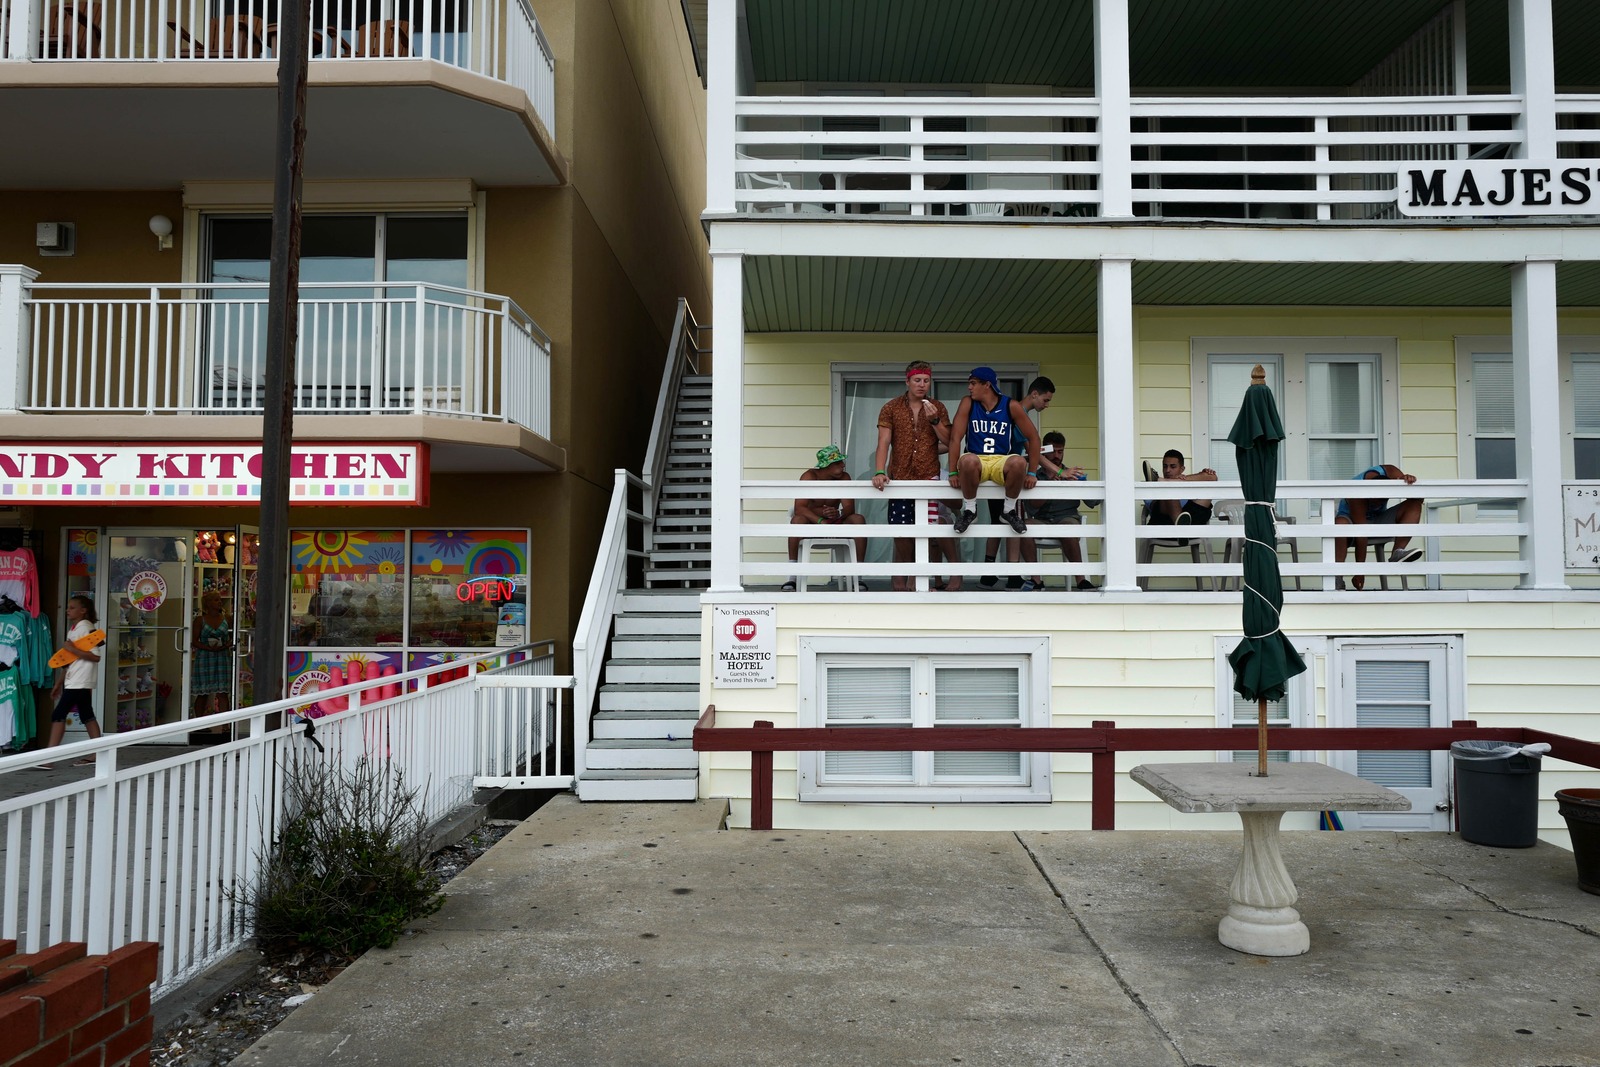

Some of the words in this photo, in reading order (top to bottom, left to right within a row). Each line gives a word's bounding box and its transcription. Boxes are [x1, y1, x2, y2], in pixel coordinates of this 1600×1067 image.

[1408, 167, 1600, 206] MAJES
[972, 420, 1007, 435] DUKE
[983, 437, 995, 453] 2
[1592, 556, 1600, 564] 4
[456, 582, 512, 602] OPEN
[732, 609, 770, 617] Trespassing
[736, 625, 755, 635] STOP
[720, 652, 771, 661] MAJESTIC
[727, 662, 763, 670] HOTEL
[292, 673, 309, 695] CANDY
[311, 672, 331, 684] KITC
